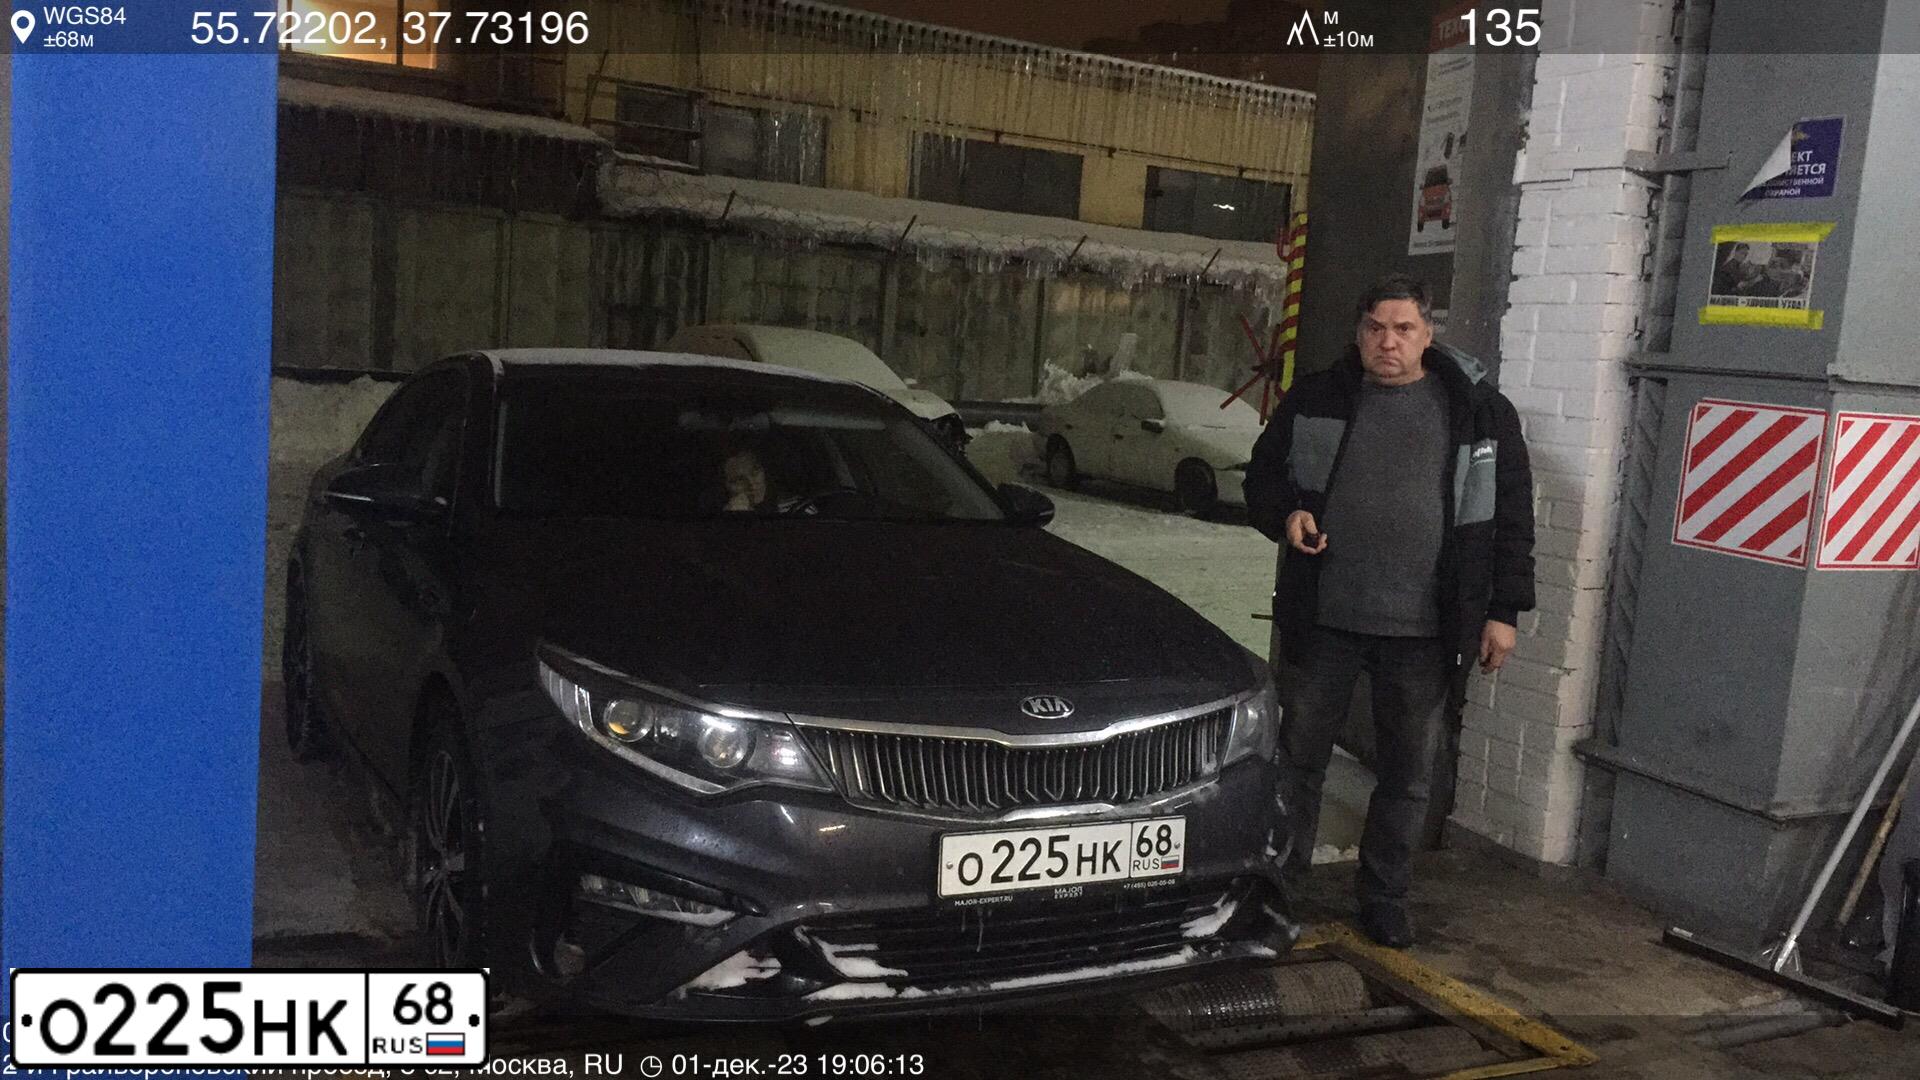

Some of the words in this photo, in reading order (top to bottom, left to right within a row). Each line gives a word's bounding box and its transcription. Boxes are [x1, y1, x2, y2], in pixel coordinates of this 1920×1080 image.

[1027, 698, 1070, 713] KIA
[1135, 824, 1173, 858] 68
[1132, 857, 1161, 872] RUS
[1054, 886, 1083, 894] MAJOR
